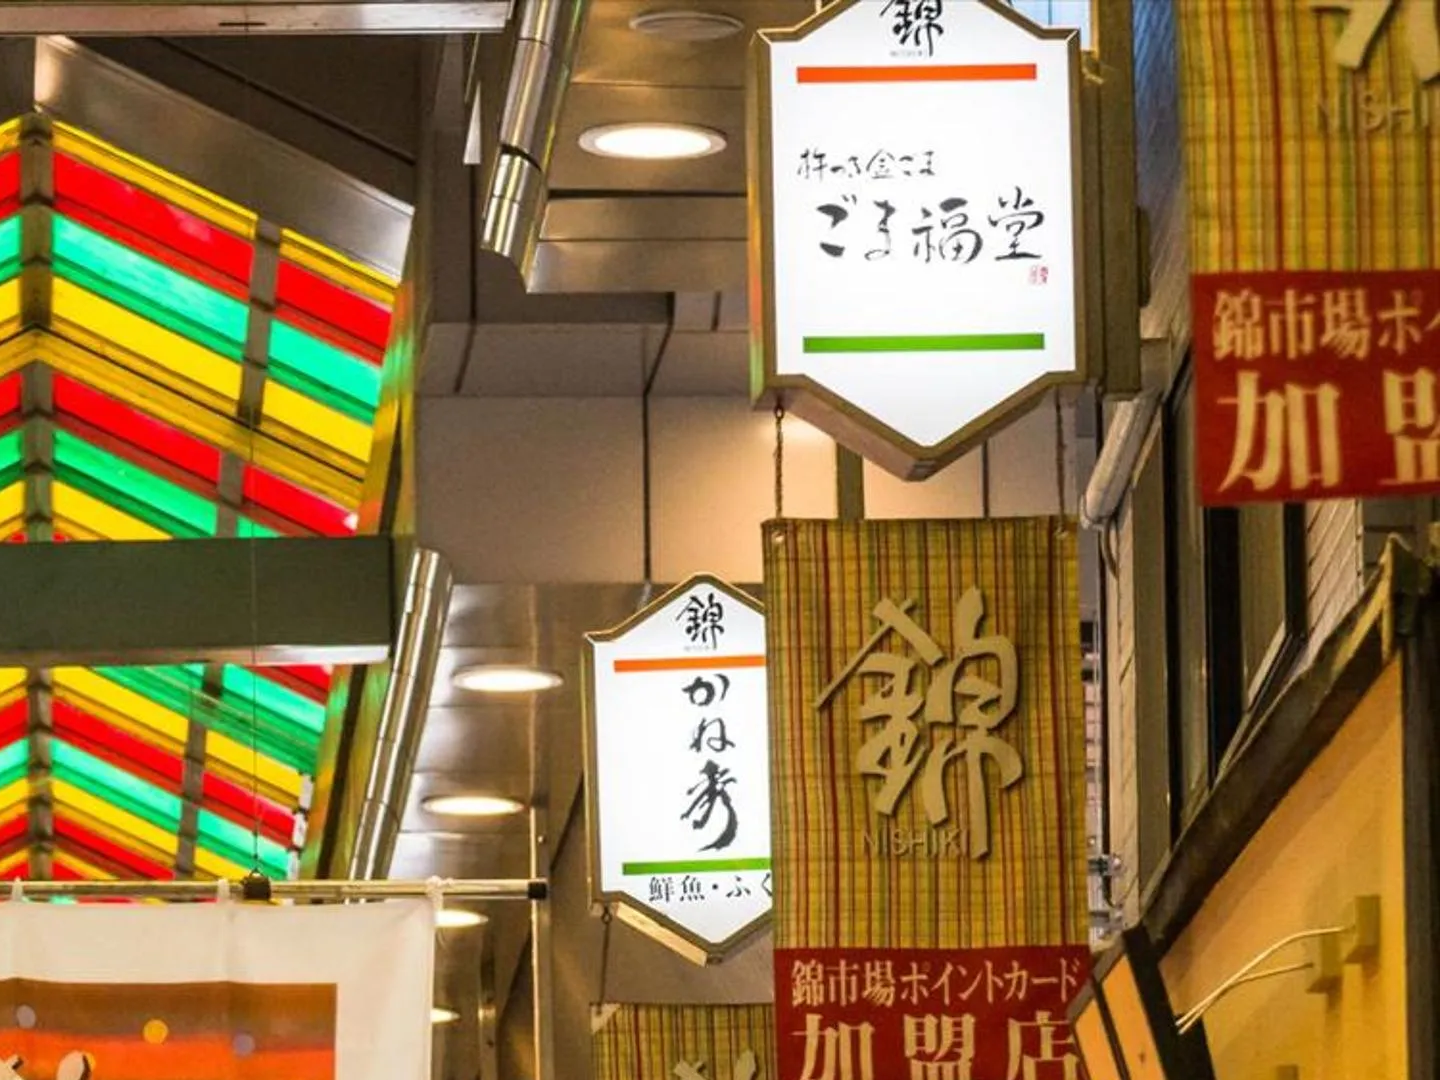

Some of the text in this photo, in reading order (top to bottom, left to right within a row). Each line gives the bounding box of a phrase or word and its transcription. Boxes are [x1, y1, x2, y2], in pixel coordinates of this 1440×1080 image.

[816, 186, 1045, 264] ごま福堂
[1213, 288, 1440, 361] 錦市場ポ
[676, 593, 725, 650] 錦
[814, 586, 1025, 860] 錦
[862, 829, 968, 857] NISHIKI
[791, 956, 1080, 1008] 錦市場ポイントカード
